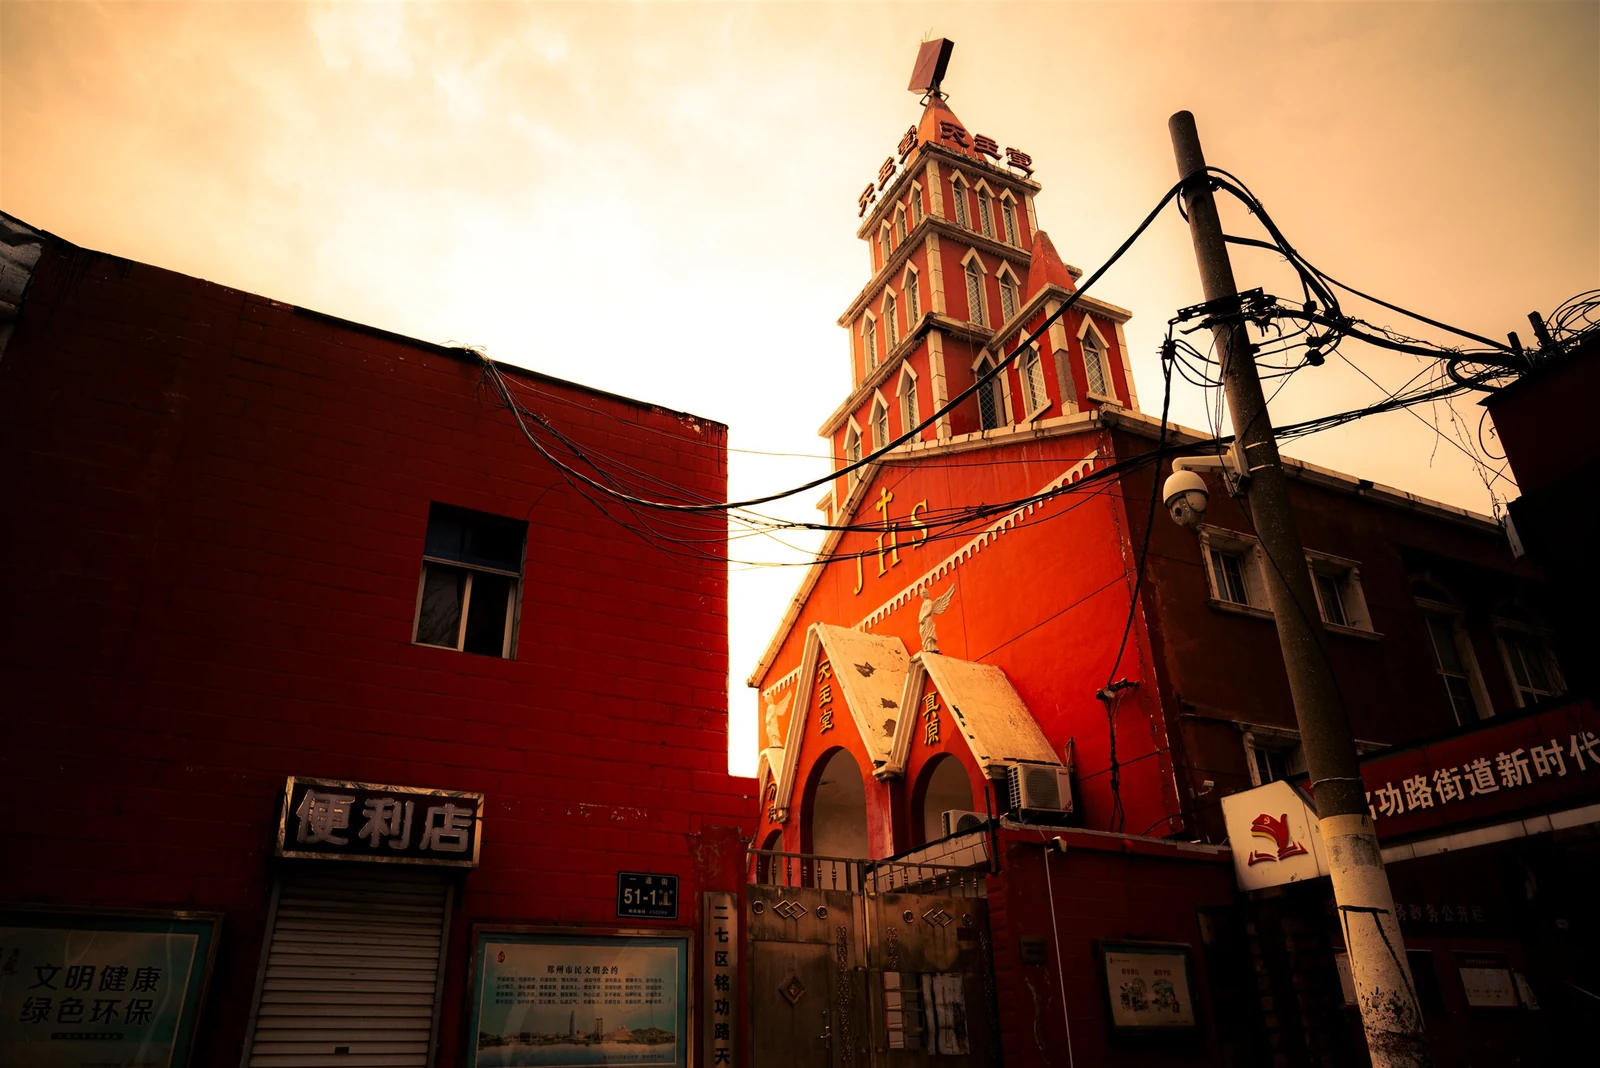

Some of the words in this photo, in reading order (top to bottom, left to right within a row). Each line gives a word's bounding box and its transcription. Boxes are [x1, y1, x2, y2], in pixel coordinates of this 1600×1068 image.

[939, 120, 1035, 180] 天主堂
[818, 658, 834, 734] 天主堂
[922, 691, 940, 746] 真原
[1365, 731, 1600, 821] 功路街道新时代
[296, 788, 474, 853] 便利店
[28, 963, 162, 993] 文明健康
[547, 965, 619, 975] 郑州市民文明公约
[713, 905, 730, 1066] 二七区铭功路天
[19, 996, 154, 1026] 绿色环保
